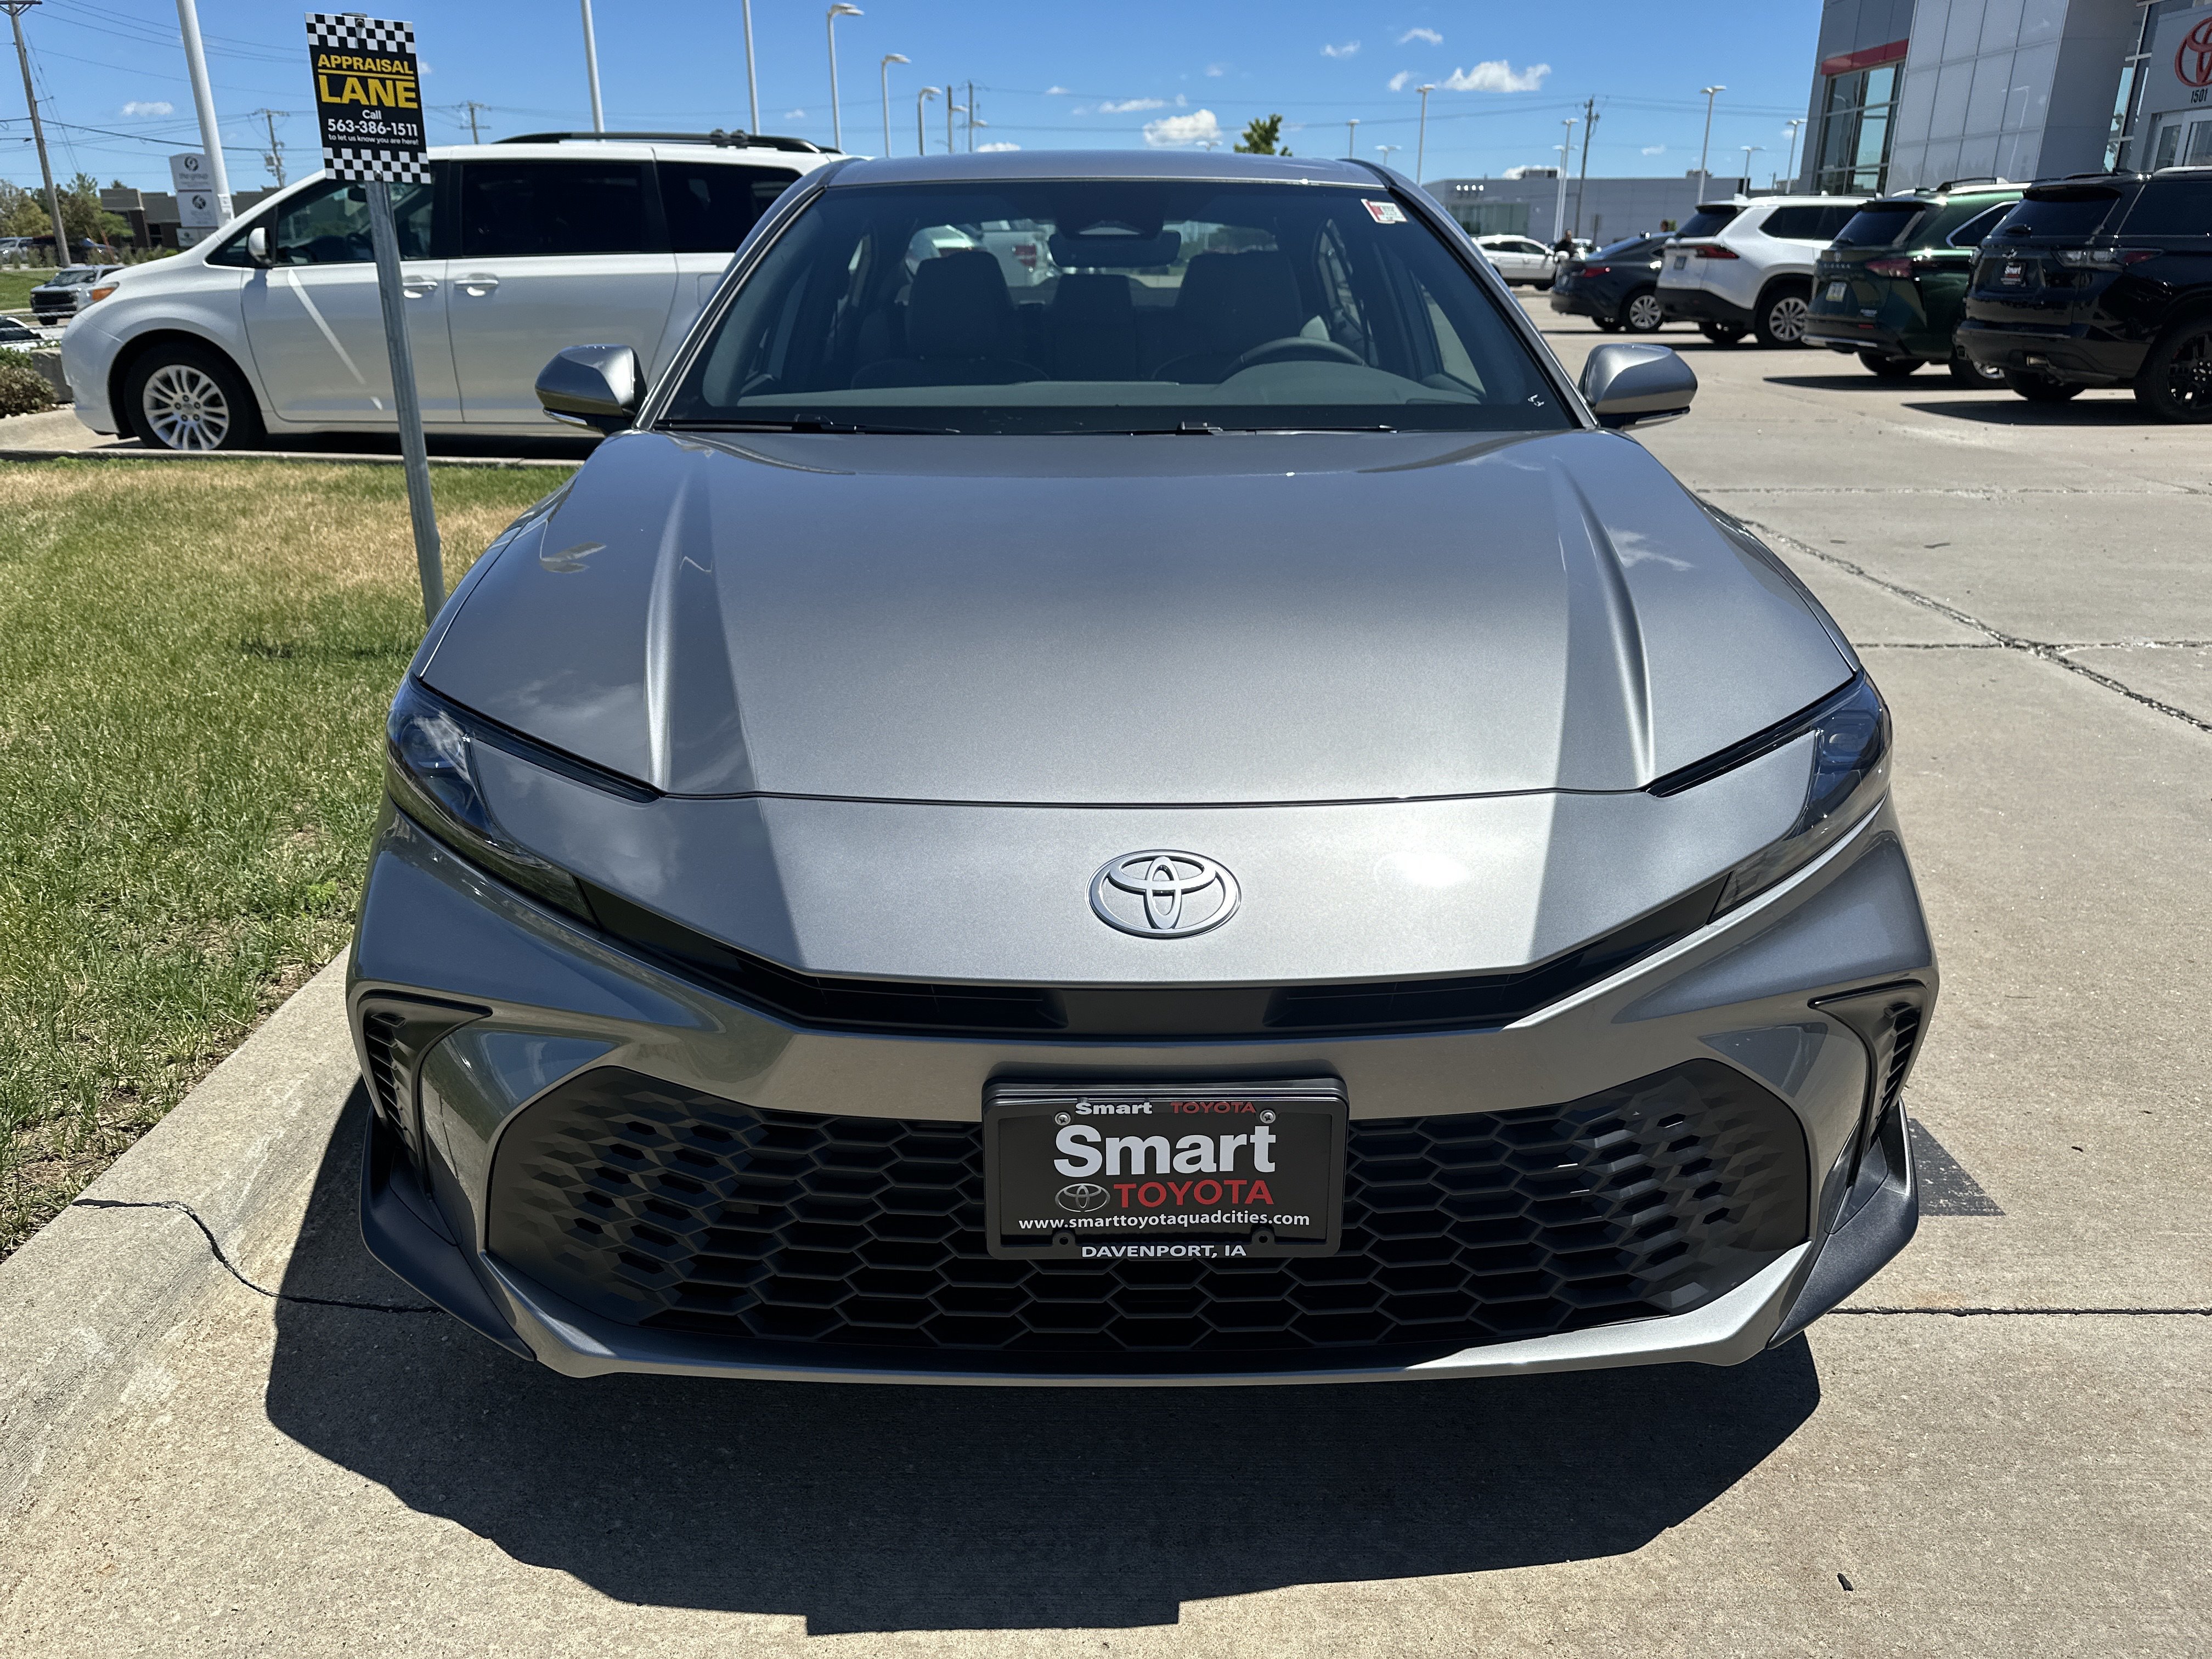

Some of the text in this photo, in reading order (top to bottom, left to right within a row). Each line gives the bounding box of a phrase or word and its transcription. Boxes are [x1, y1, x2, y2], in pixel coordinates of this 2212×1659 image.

[318, 54, 414, 75] APPRAISAL
[318, 75, 418, 109] LANE
[2191, 88, 2208, 103] 1501
[362, 110, 382, 120] Call
[328, 119, 418, 137] 563-386-1511
[1075, 1101, 1256, 1115] Smart TOYOTA
[1053, 1125, 1276, 1177] Smart
[1114, 1180, 1274, 1207] TOYOTA
[1019, 1210, 1310, 1229] www.smarttoyotaquadcities.com
[1082, 1245, 1246, 1258] DAVENPORT, IA
